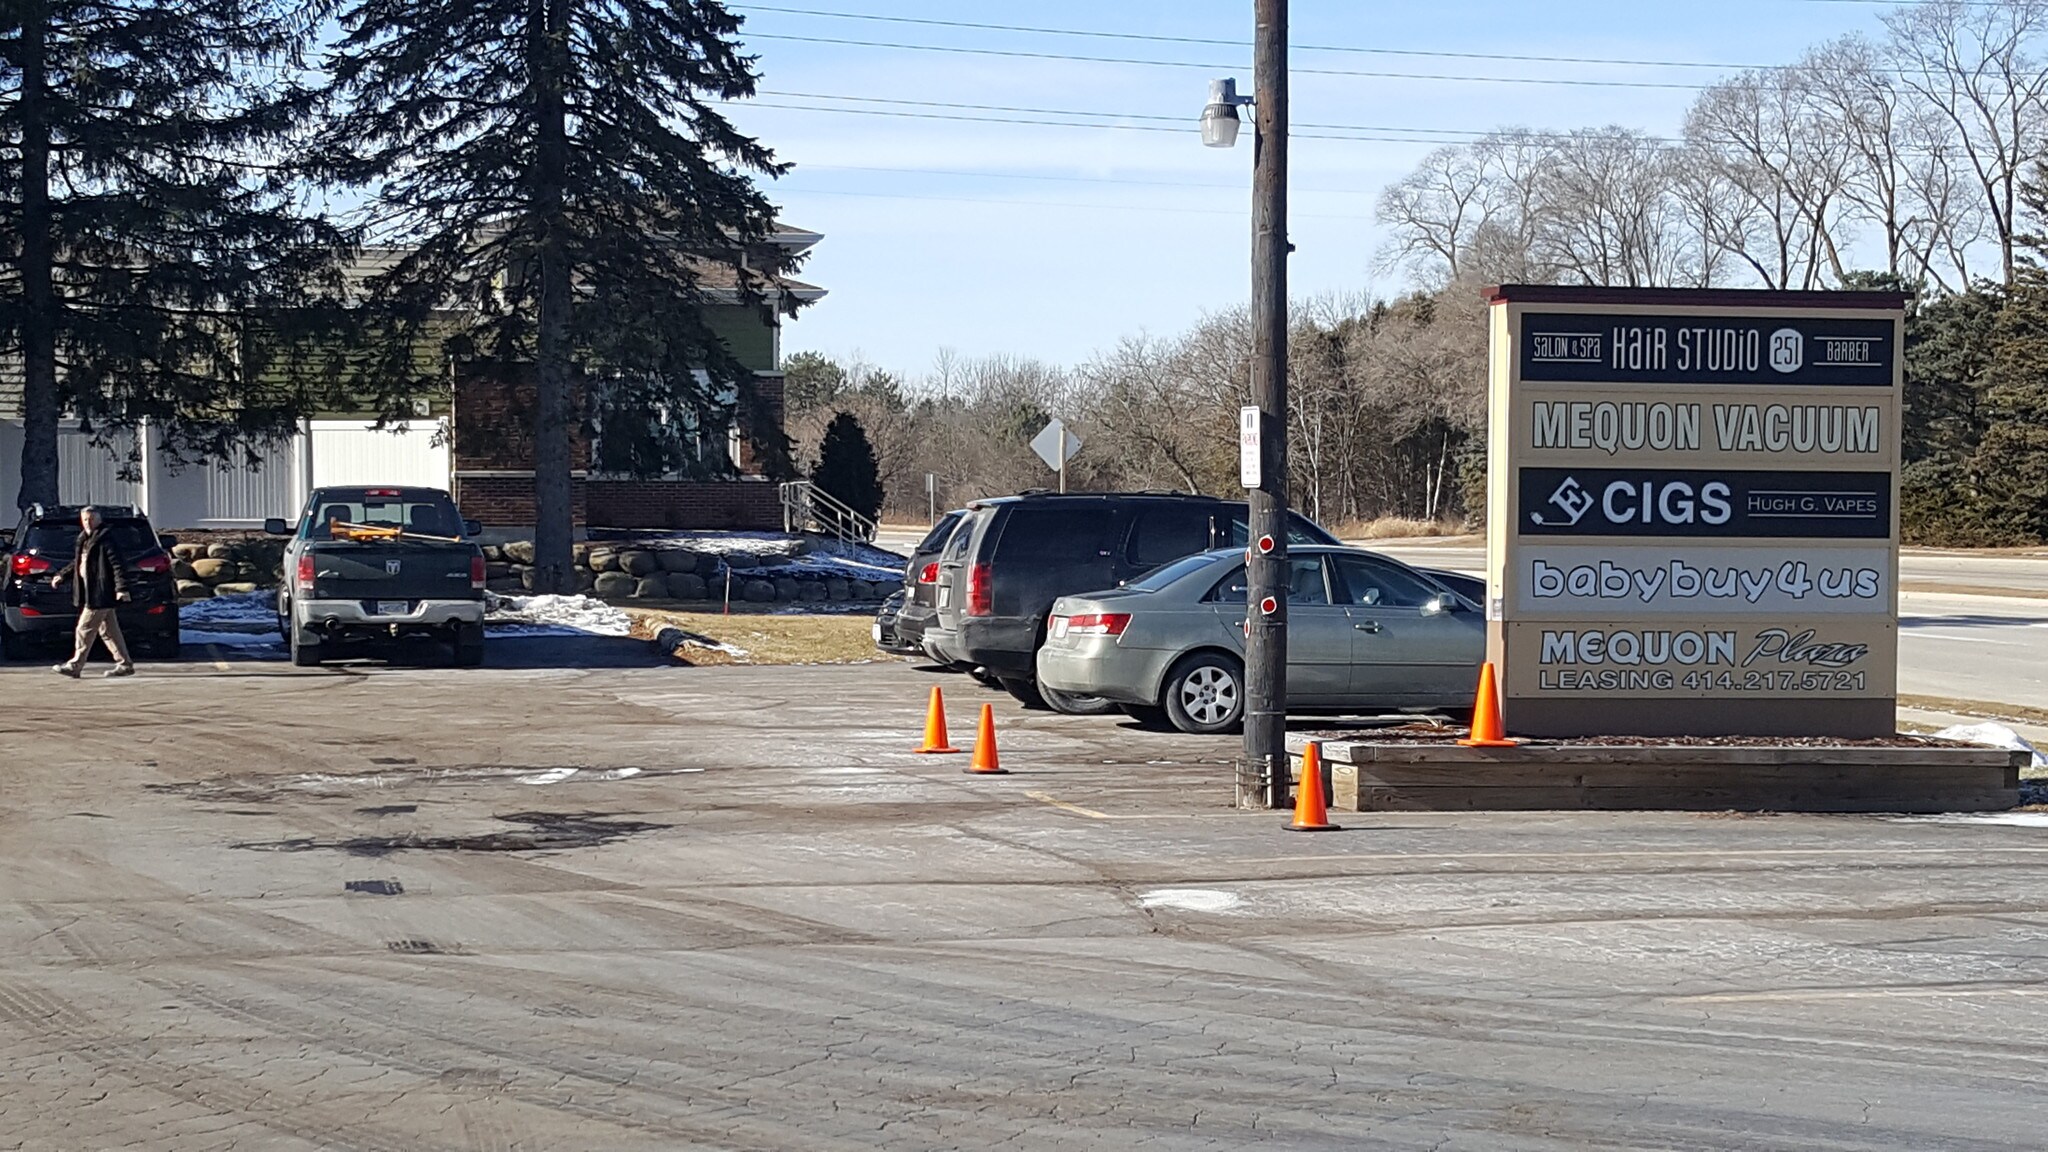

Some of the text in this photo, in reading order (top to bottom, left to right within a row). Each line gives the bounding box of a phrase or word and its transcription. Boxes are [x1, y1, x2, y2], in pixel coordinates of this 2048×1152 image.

[1572, 340, 1578, 356] &
[1773, 336, 1800, 365] 251
[1532, 401, 1880, 456] MEQUON VACUUM
[1602, 480, 1732, 525] CIGS
[1800, 497, 1819, 511] G.
[1532, 560, 1881, 603] babybuy4us
[1540, 628, 1868, 668] MEQUON Plaza
[1539, 671, 1866, 691] LEASING 414.217.5721
